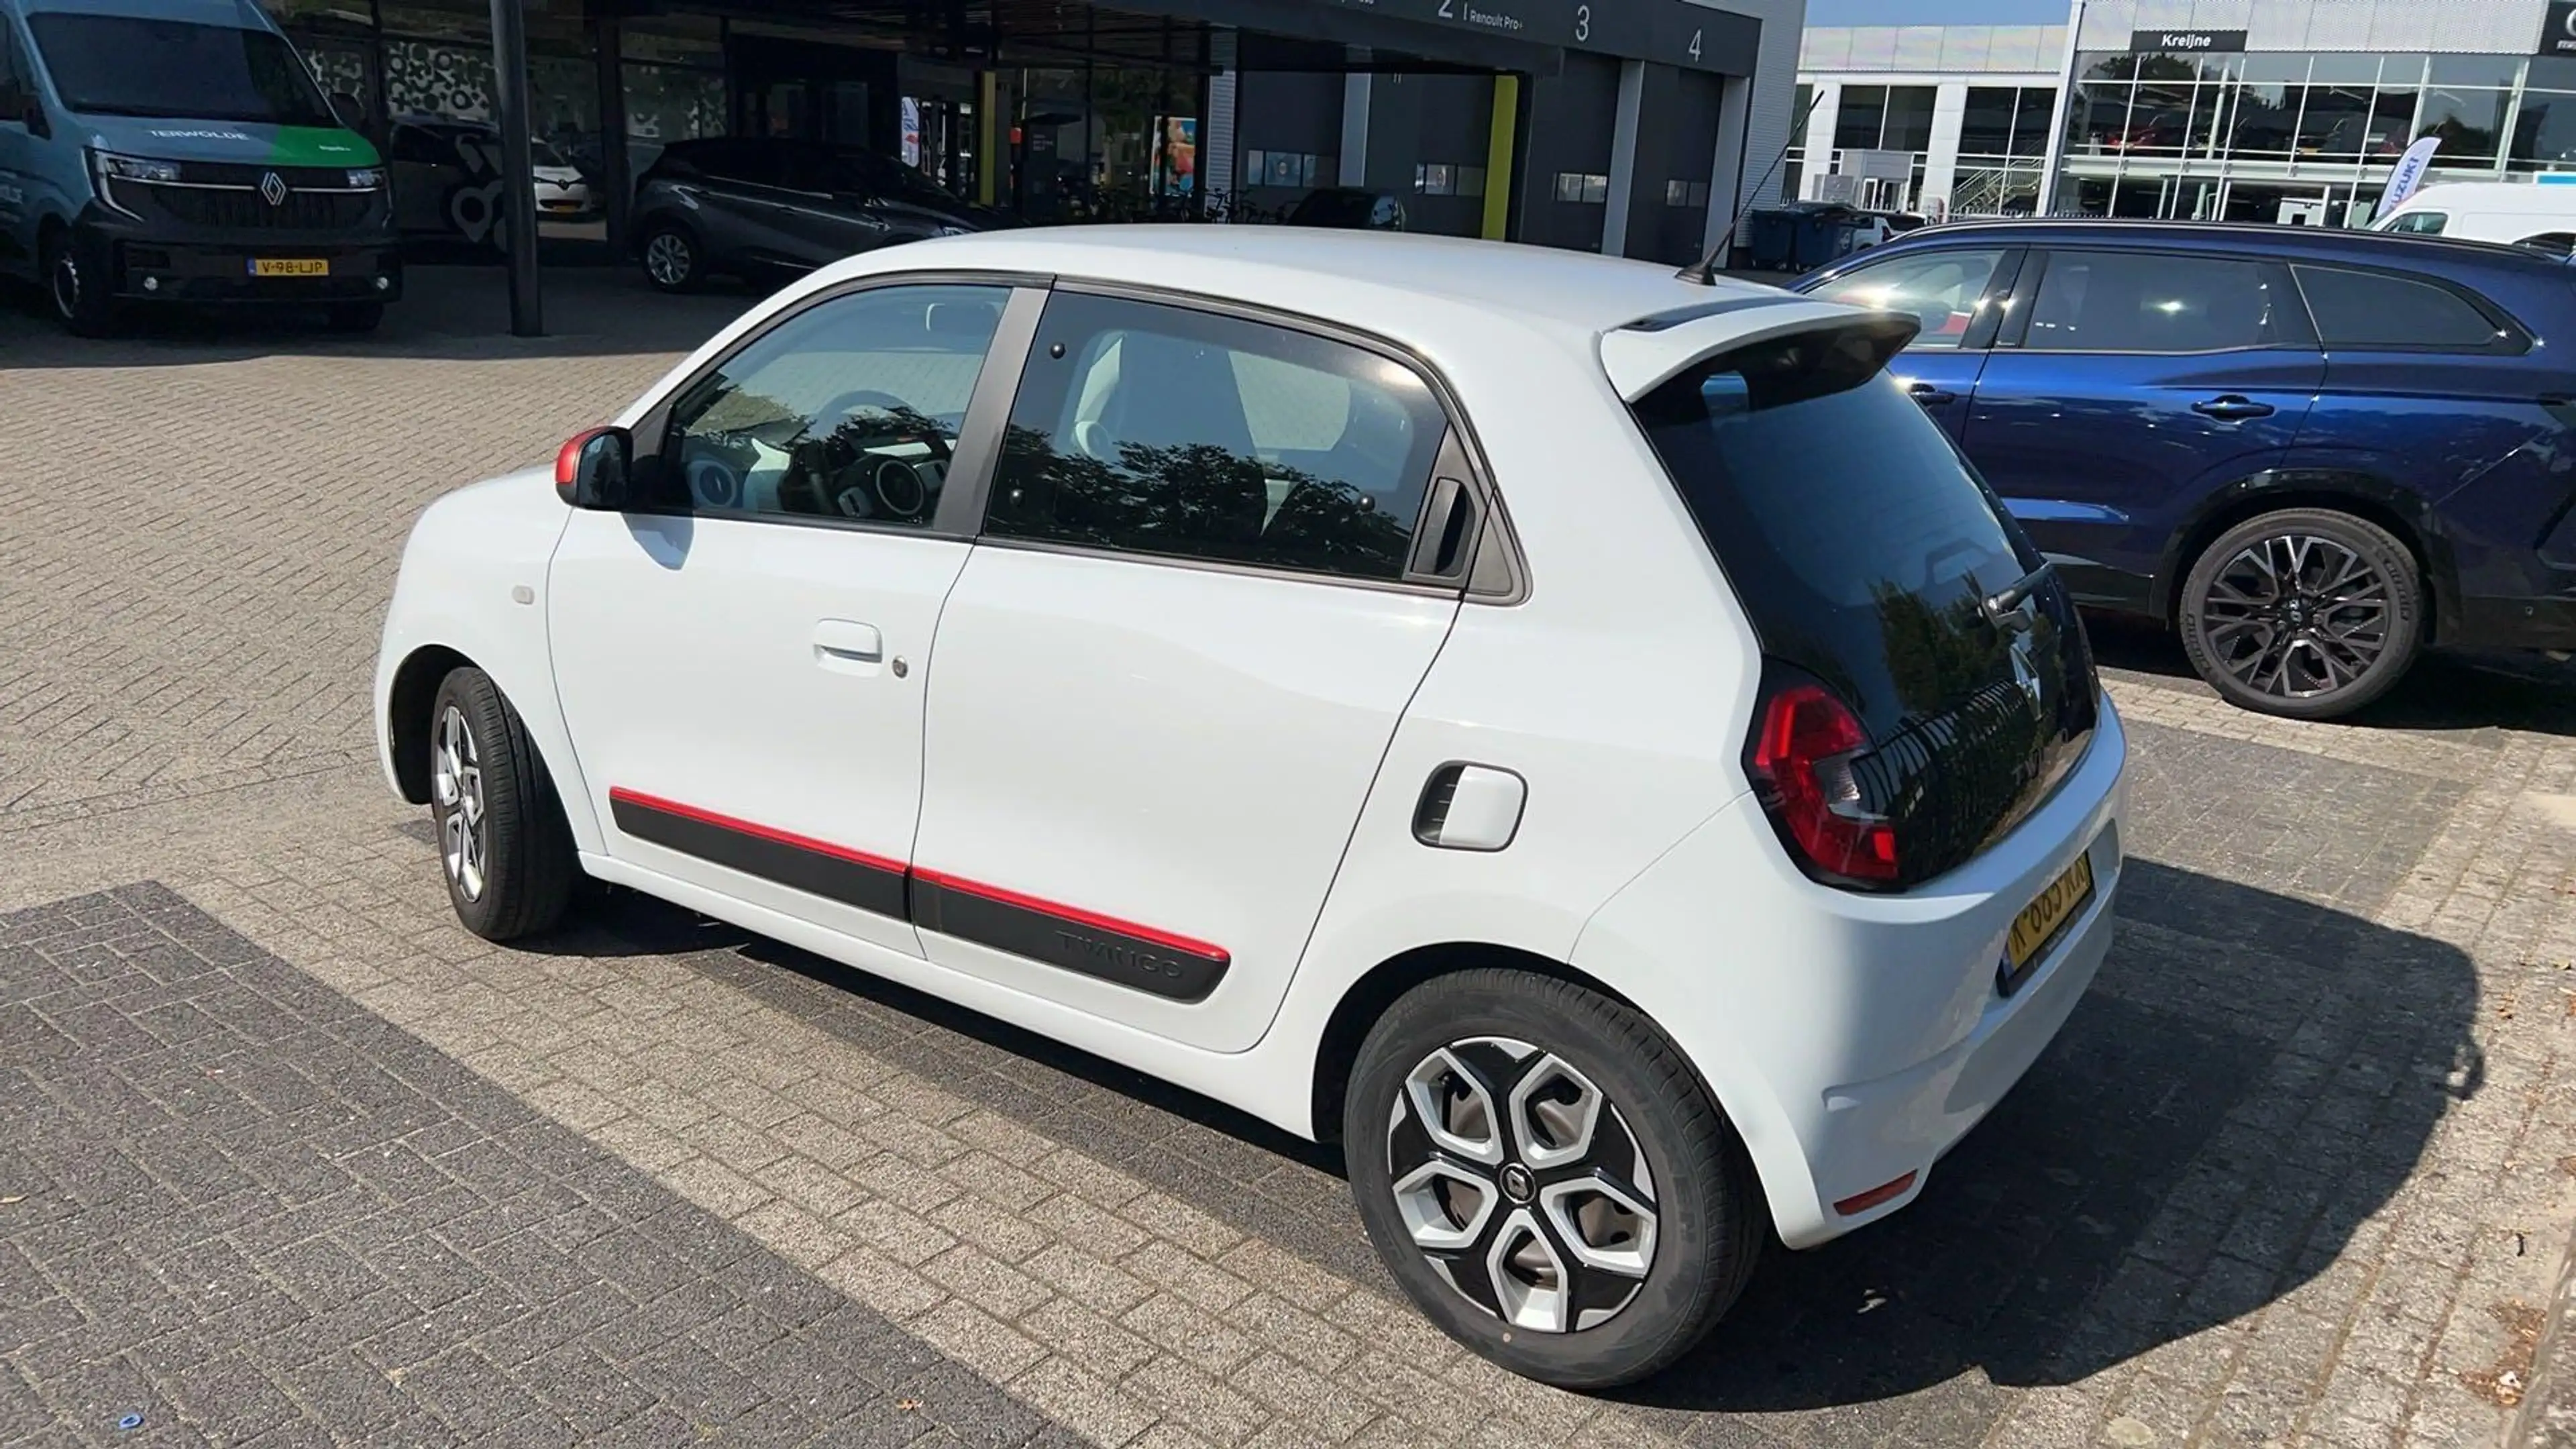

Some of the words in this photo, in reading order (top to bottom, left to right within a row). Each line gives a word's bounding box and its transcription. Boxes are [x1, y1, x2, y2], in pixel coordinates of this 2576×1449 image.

[1576, 5, 1590, 42] 3
[1688, 29, 1701, 62] 4
[2161, 34, 2211, 49] Kreijne
[1054, 930, 1182, 977] TWINGO
